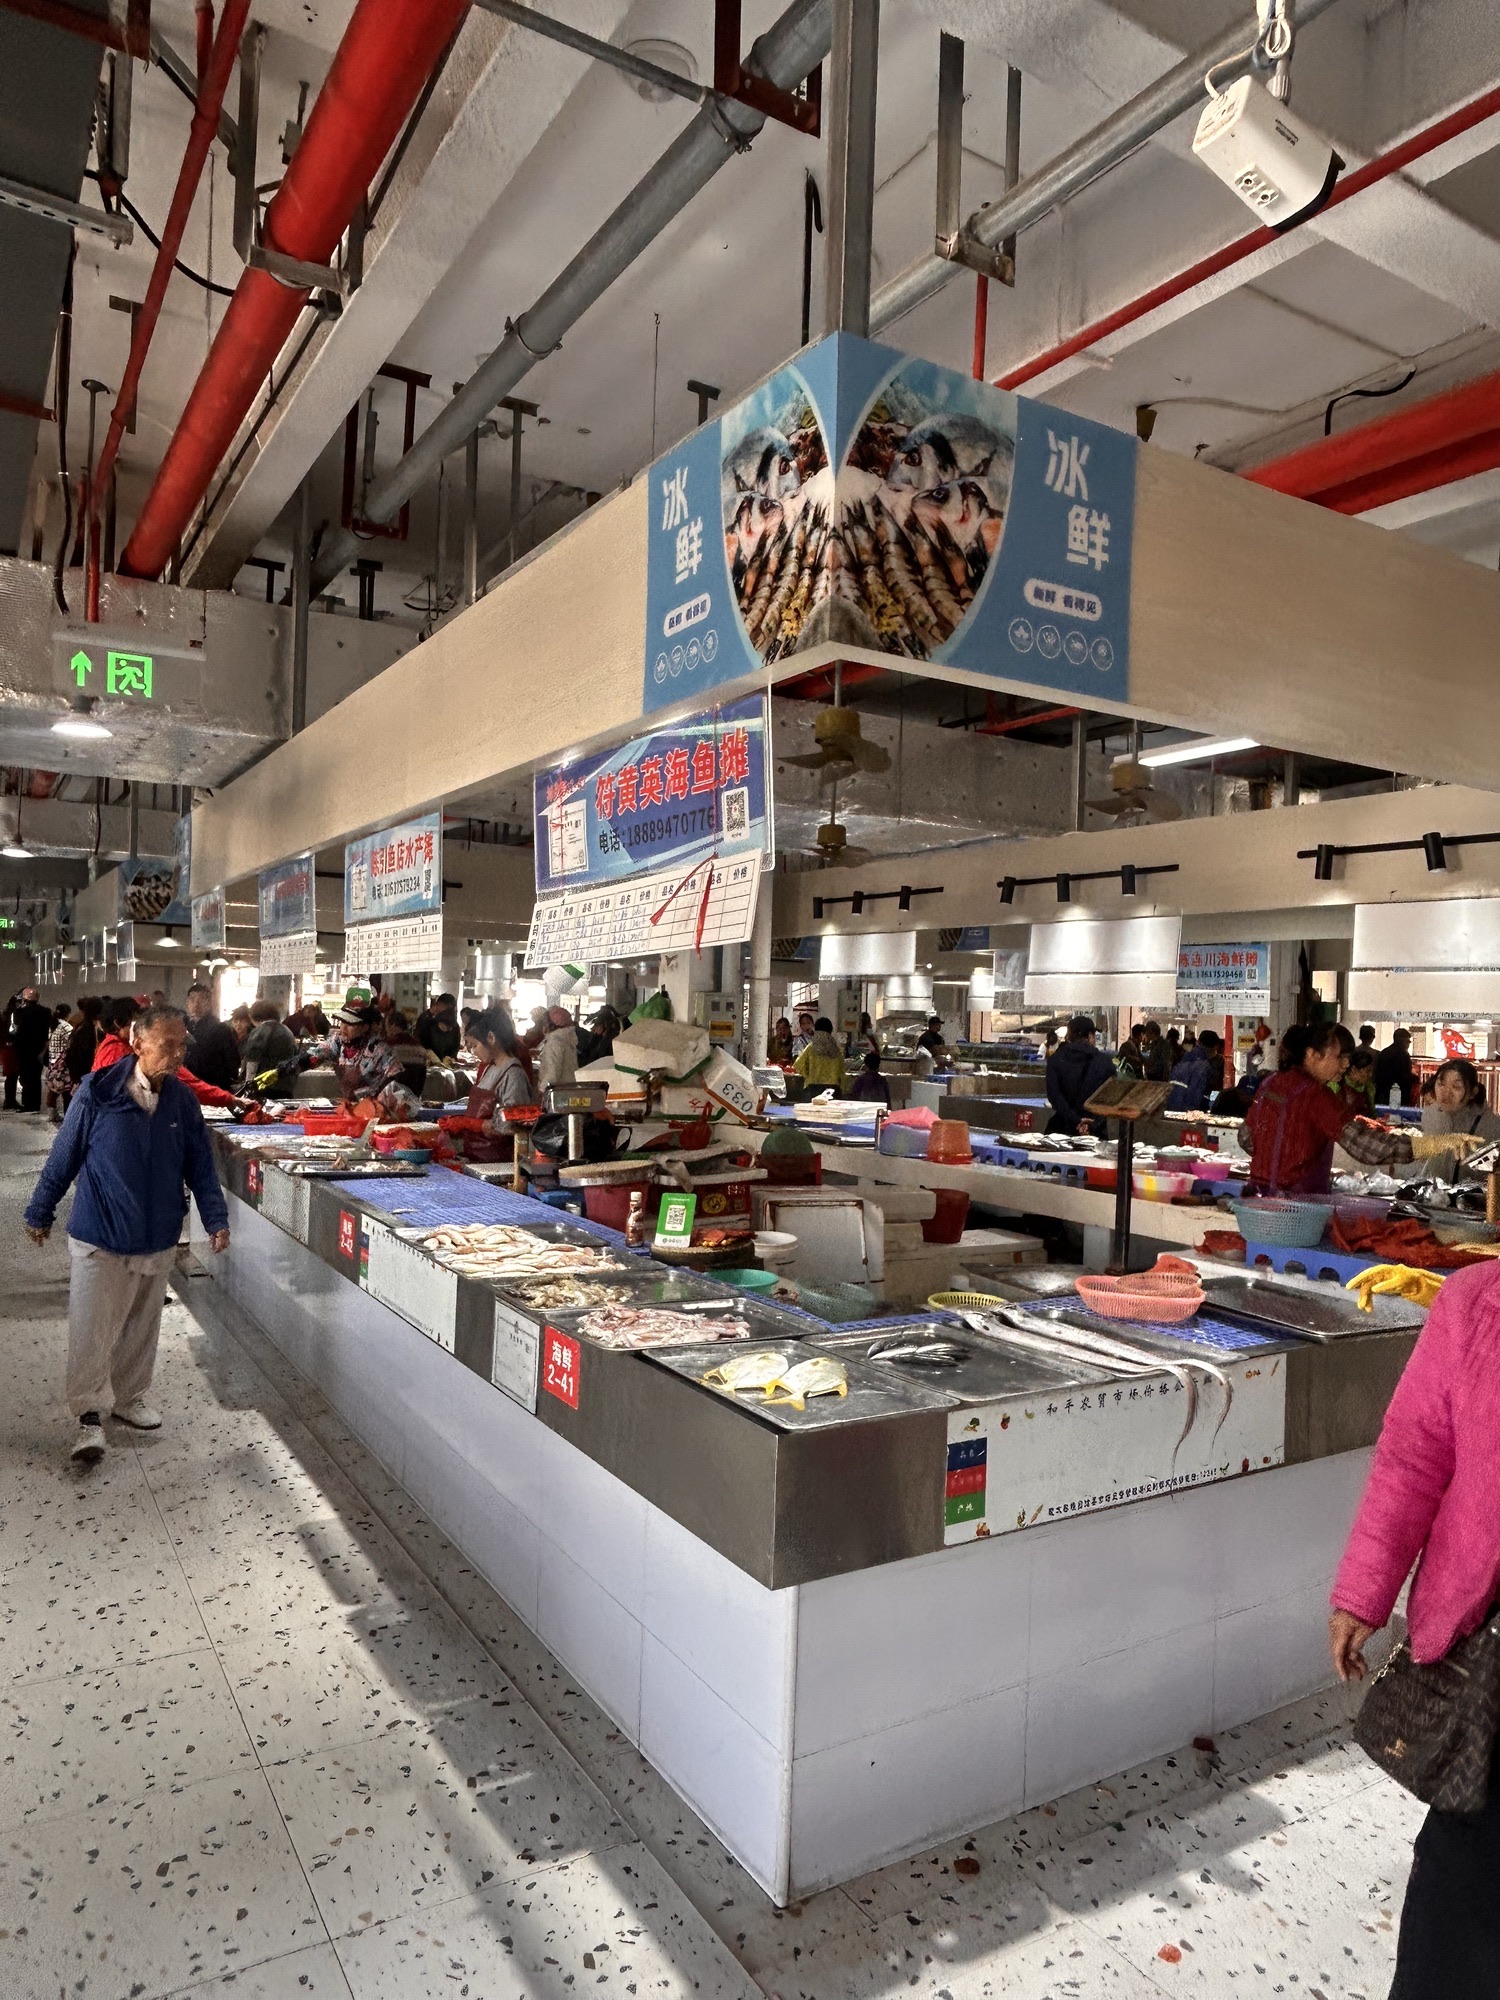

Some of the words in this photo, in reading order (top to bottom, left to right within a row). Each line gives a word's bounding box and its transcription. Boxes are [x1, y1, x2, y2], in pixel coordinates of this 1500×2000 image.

[662, 466, 703, 585] 冰鲜
[1044, 429, 1111, 572] 冰鲜
[595, 726, 749, 821] 符黄英海鱼摊
[547, 1363, 574, 1397] 2-41
[552, 1340, 573, 1372] 海鲜
